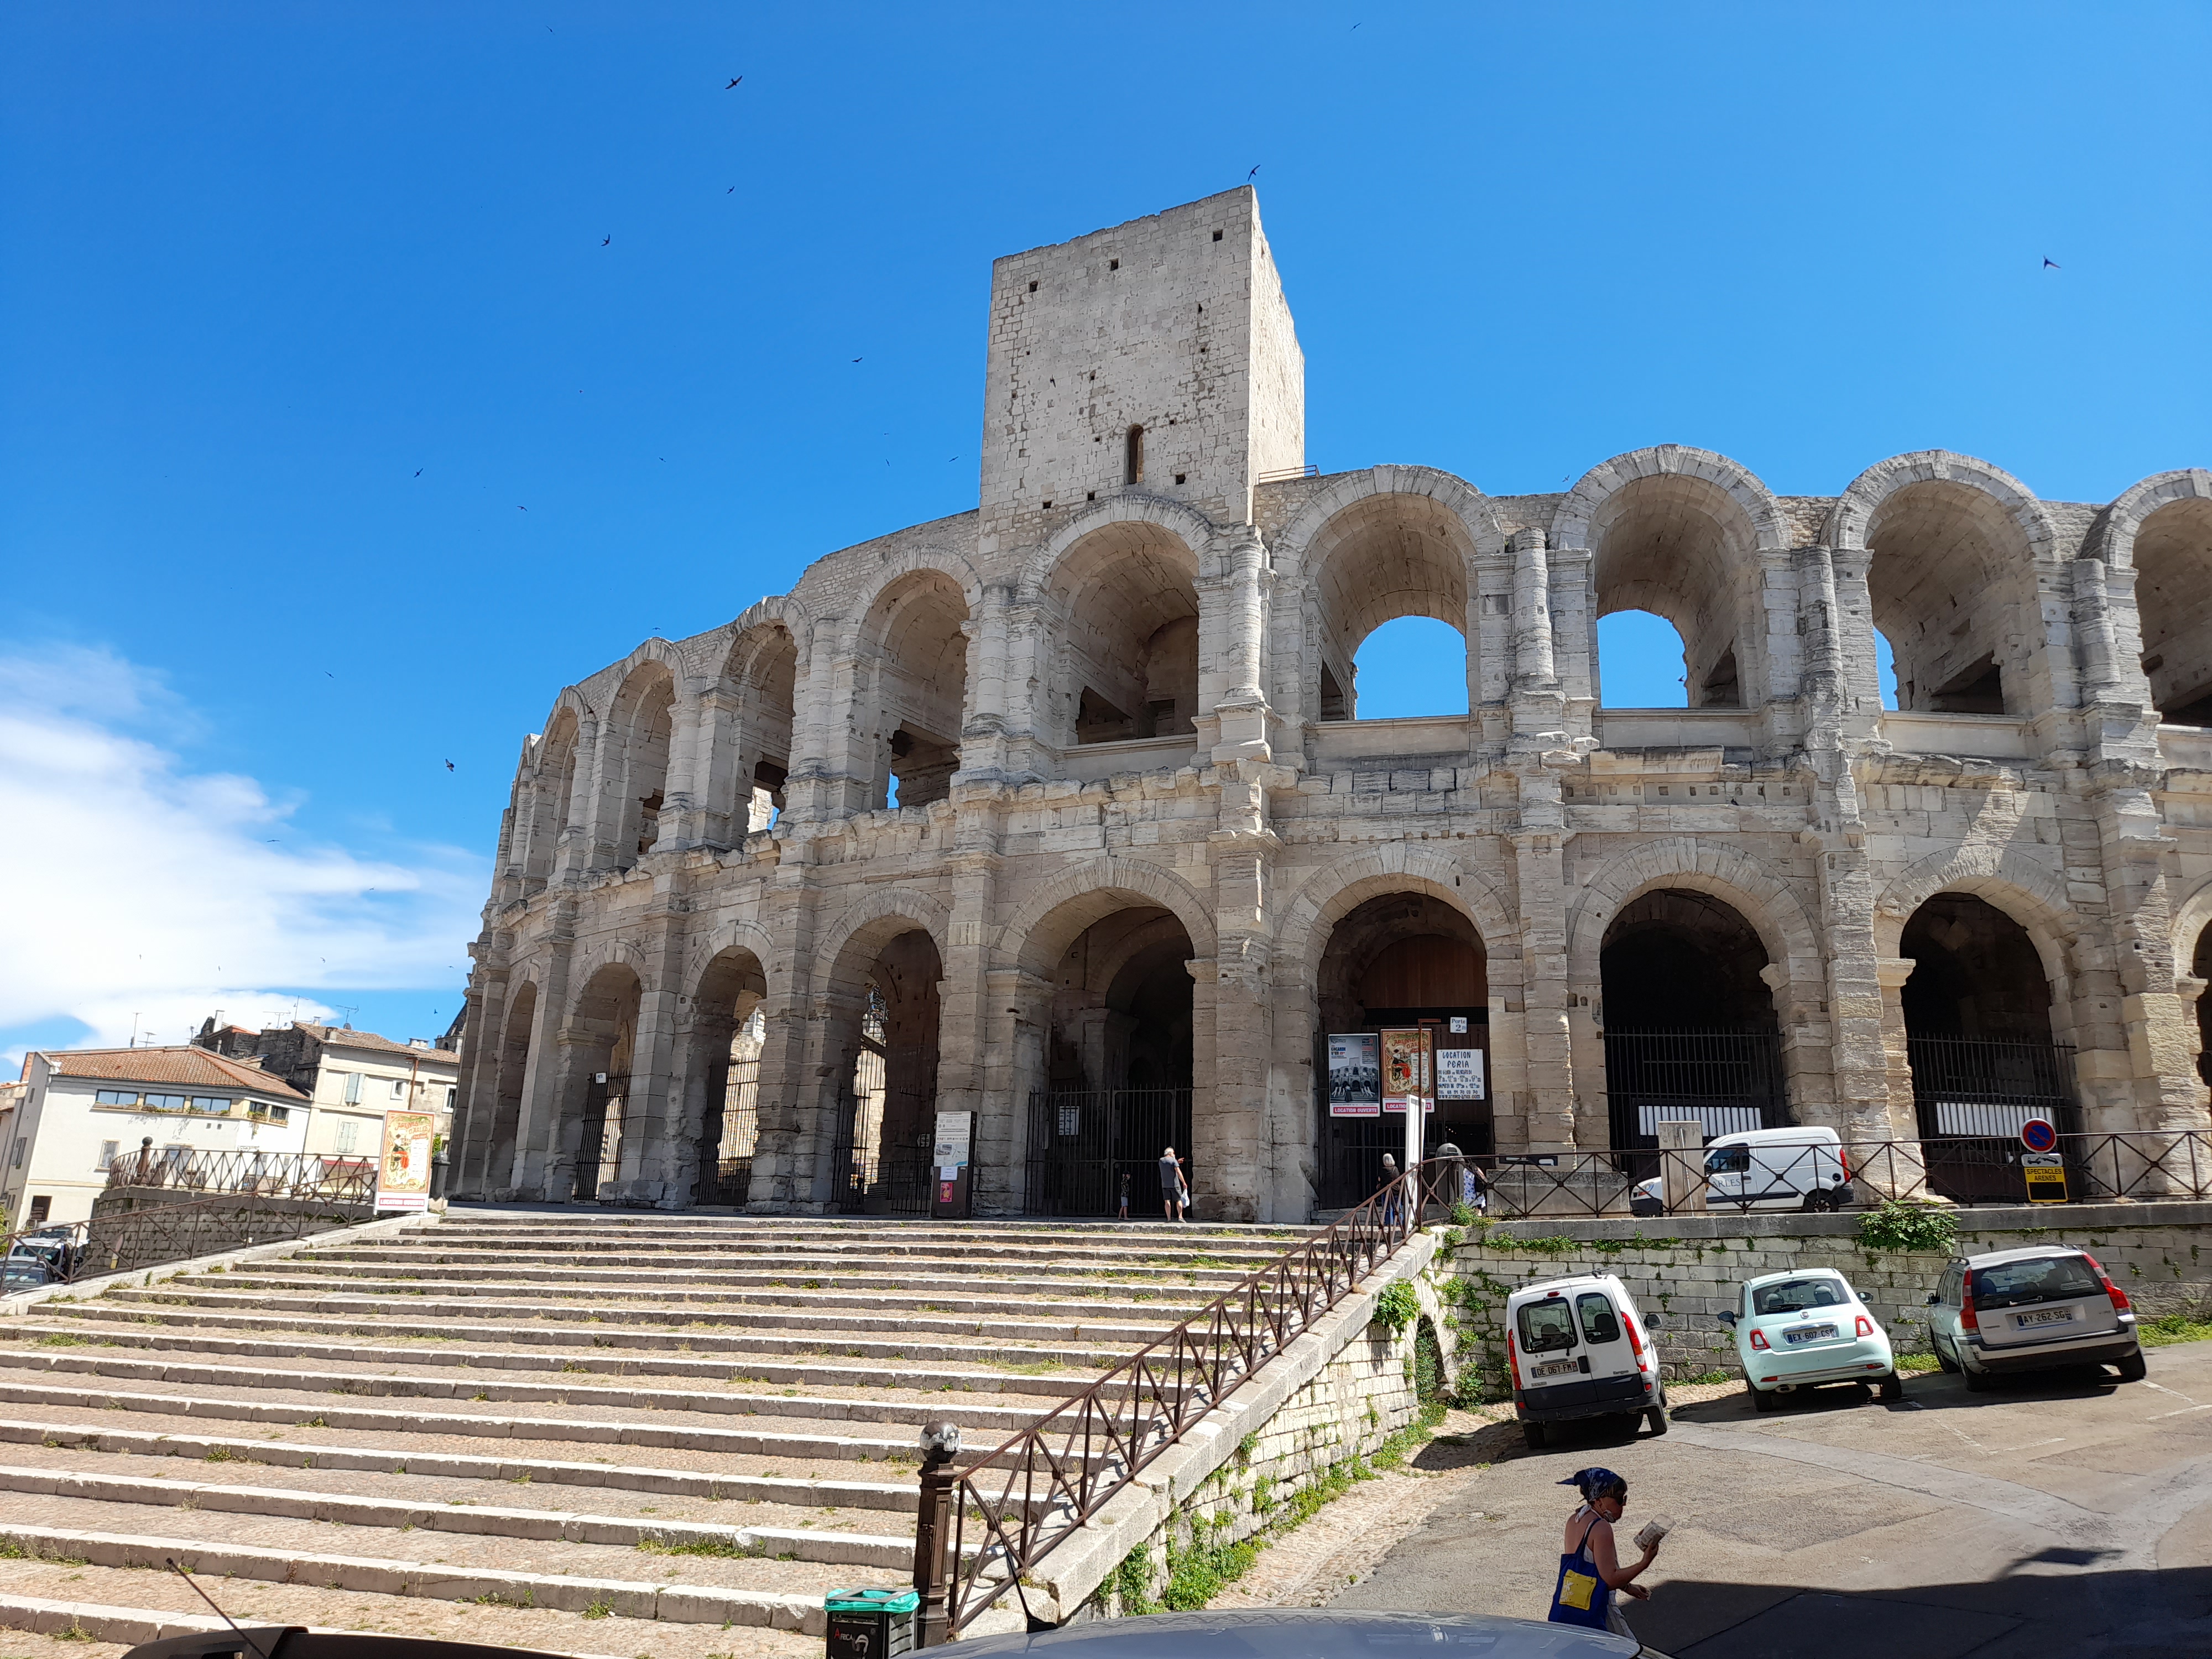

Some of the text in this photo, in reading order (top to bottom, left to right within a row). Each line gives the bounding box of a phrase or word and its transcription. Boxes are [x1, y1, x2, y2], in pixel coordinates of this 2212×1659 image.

[2023, 1311, 2065, 1323] AY-262-SG
[1792, 1330, 1830, 1342] EX-607-CS
[1537, 1363, 1572, 1376] DE-067-FM
